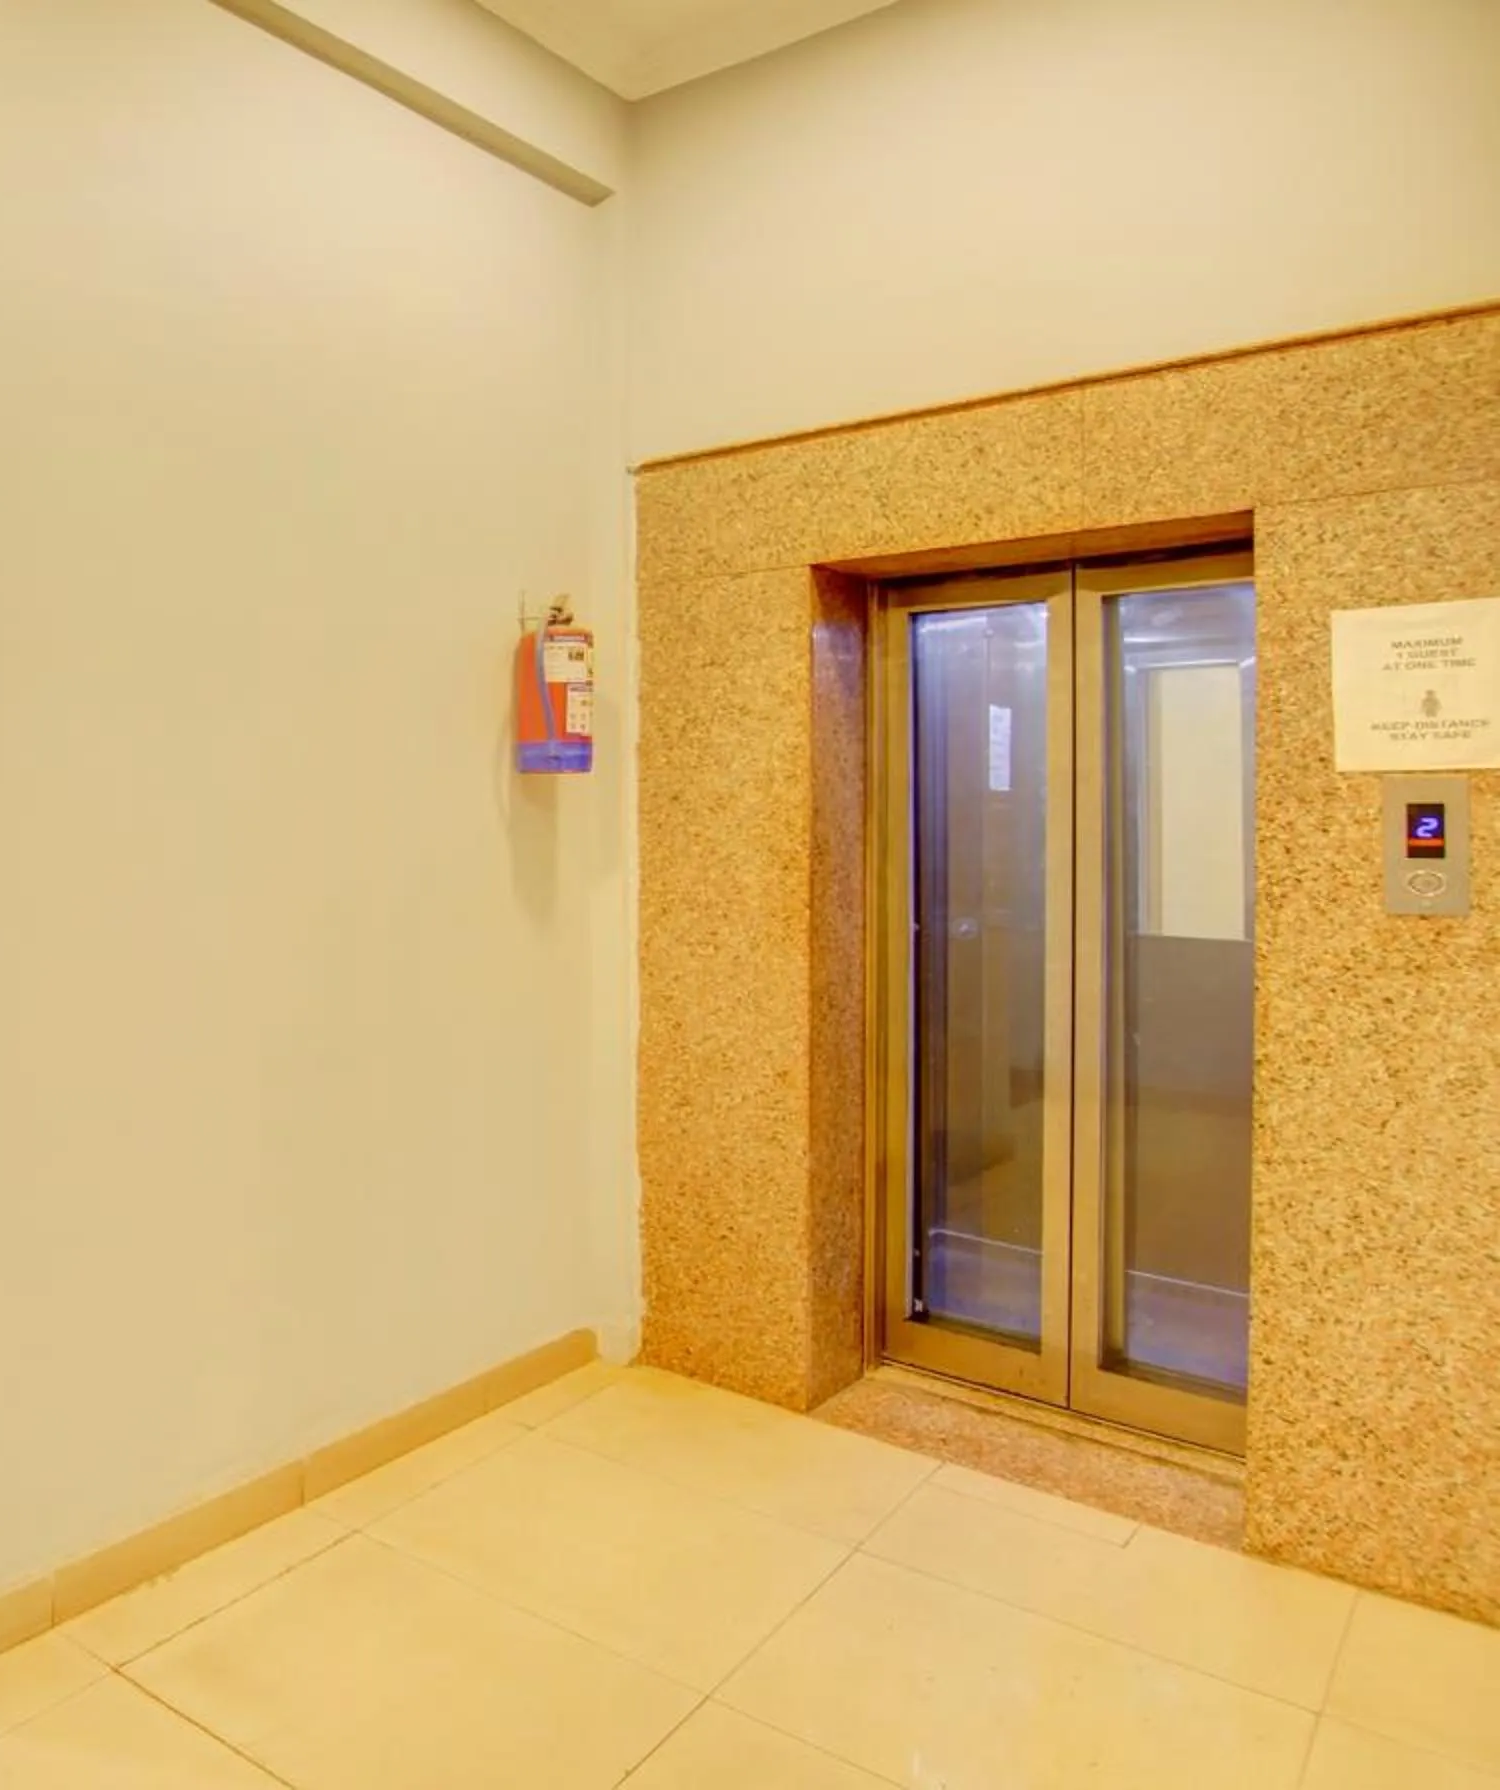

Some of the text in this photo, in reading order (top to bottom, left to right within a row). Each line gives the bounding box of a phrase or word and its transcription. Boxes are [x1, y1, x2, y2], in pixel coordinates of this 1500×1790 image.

[1390, 637, 1463, 648] MAXIMUM
[1407, 648, 1458, 659] GUEST
[1382, 658, 1476, 671] AT ONE TIME
[1370, 719, 1490, 731] KEEP DISTANCE
[1389, 729, 1472, 741] STAY SAFE
[1415, 817, 1440, 838] 2
